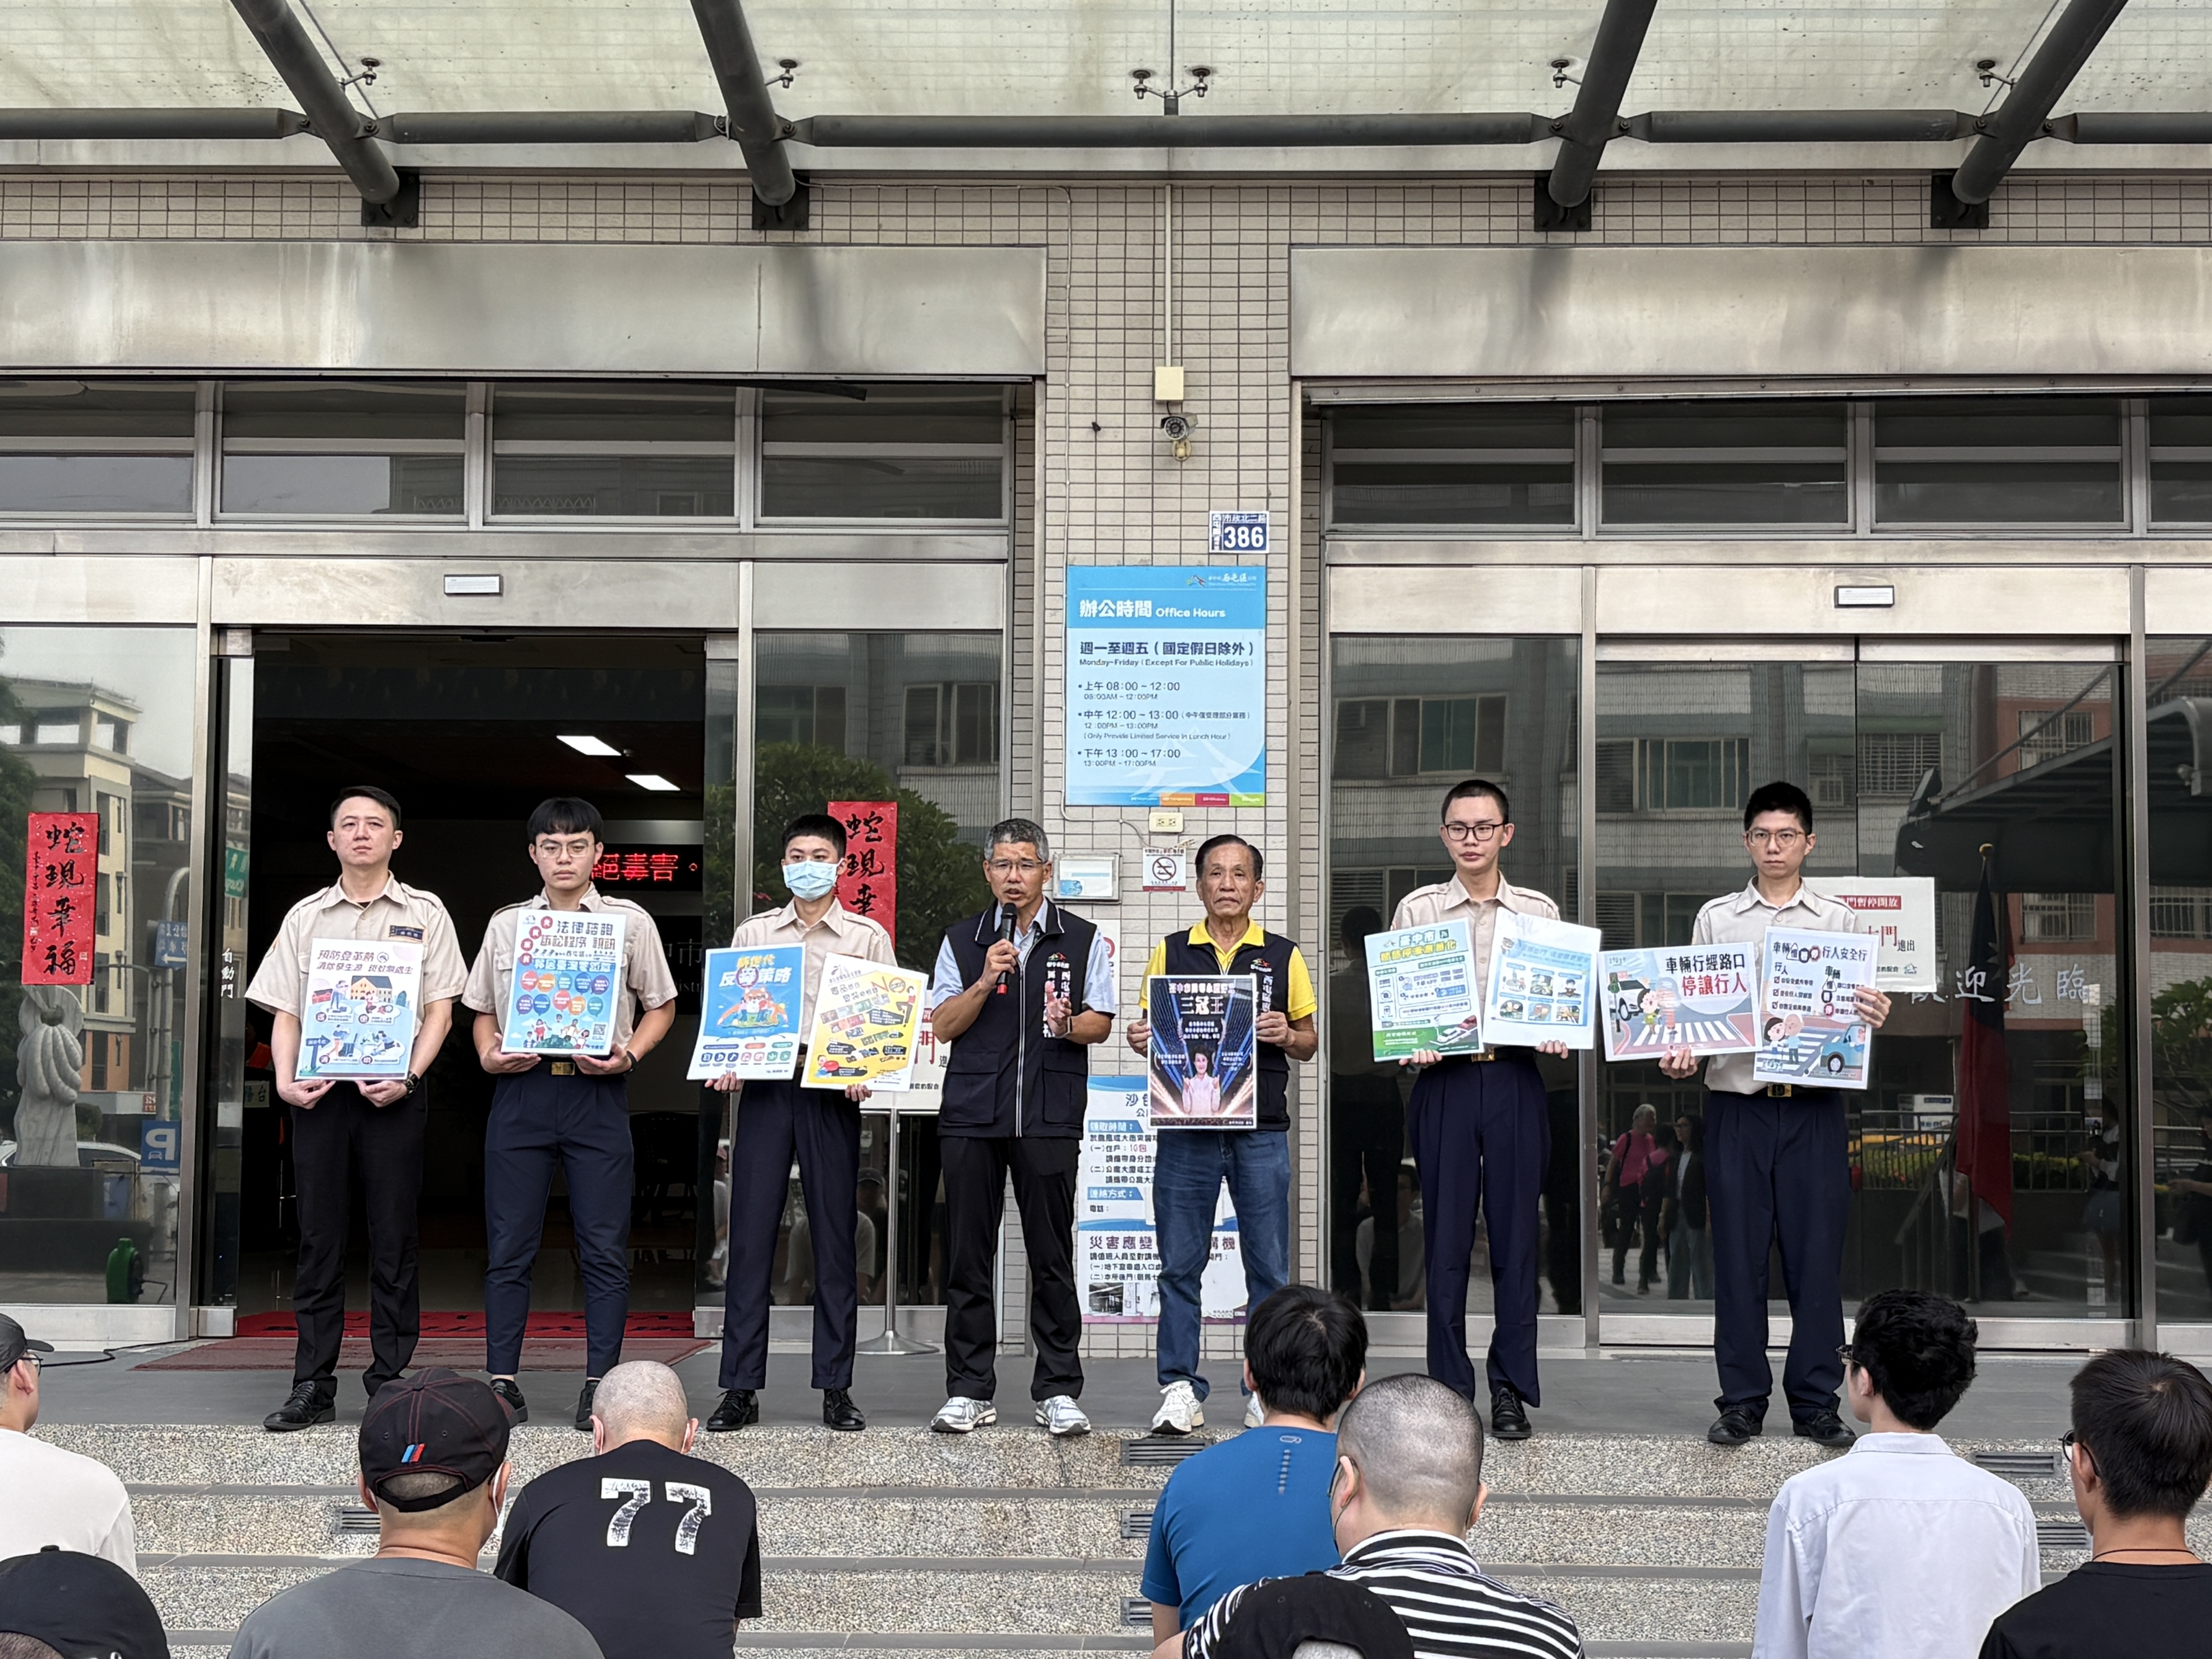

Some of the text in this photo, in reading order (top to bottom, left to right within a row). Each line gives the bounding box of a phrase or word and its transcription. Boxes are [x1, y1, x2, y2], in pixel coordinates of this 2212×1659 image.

[1224, 526, 1264, 548] 386
[1079, 599, 1226, 618] 辦公時間 Office Hours
[1084, 682, 1104, 691] 上午
[1106, 682, 1138, 690] 08:00
[1151, 682, 1180, 690] 12:00
[1084, 710, 1103, 719] 中午
[1106, 711, 1136, 719] 12:00
[1148, 711, 1178, 719] 13:00
[1085, 749, 1103, 758] 下午
[1150, 749, 1181, 758] 17:00
[1840, 896, 1898, 908] 門暫停開放
[1665, 953, 1745, 974] 車輛行經路口
[1774, 962, 1788, 975] 行人
[220, 948, 235, 999] 自動門
[719, 967, 792, 987] 反毒策略
[1681, 972, 1747, 997] 停讓行人
[1180, 995, 1224, 1015] 三冠王
[1106, 1155, 1156, 1163] 請攜帶身分證
[1106, 1176, 1154, 1184] 請攜帶公寓大
[1089, 1235, 1153, 1250] 災害應變
[600, 1476, 712, 1556] 77
